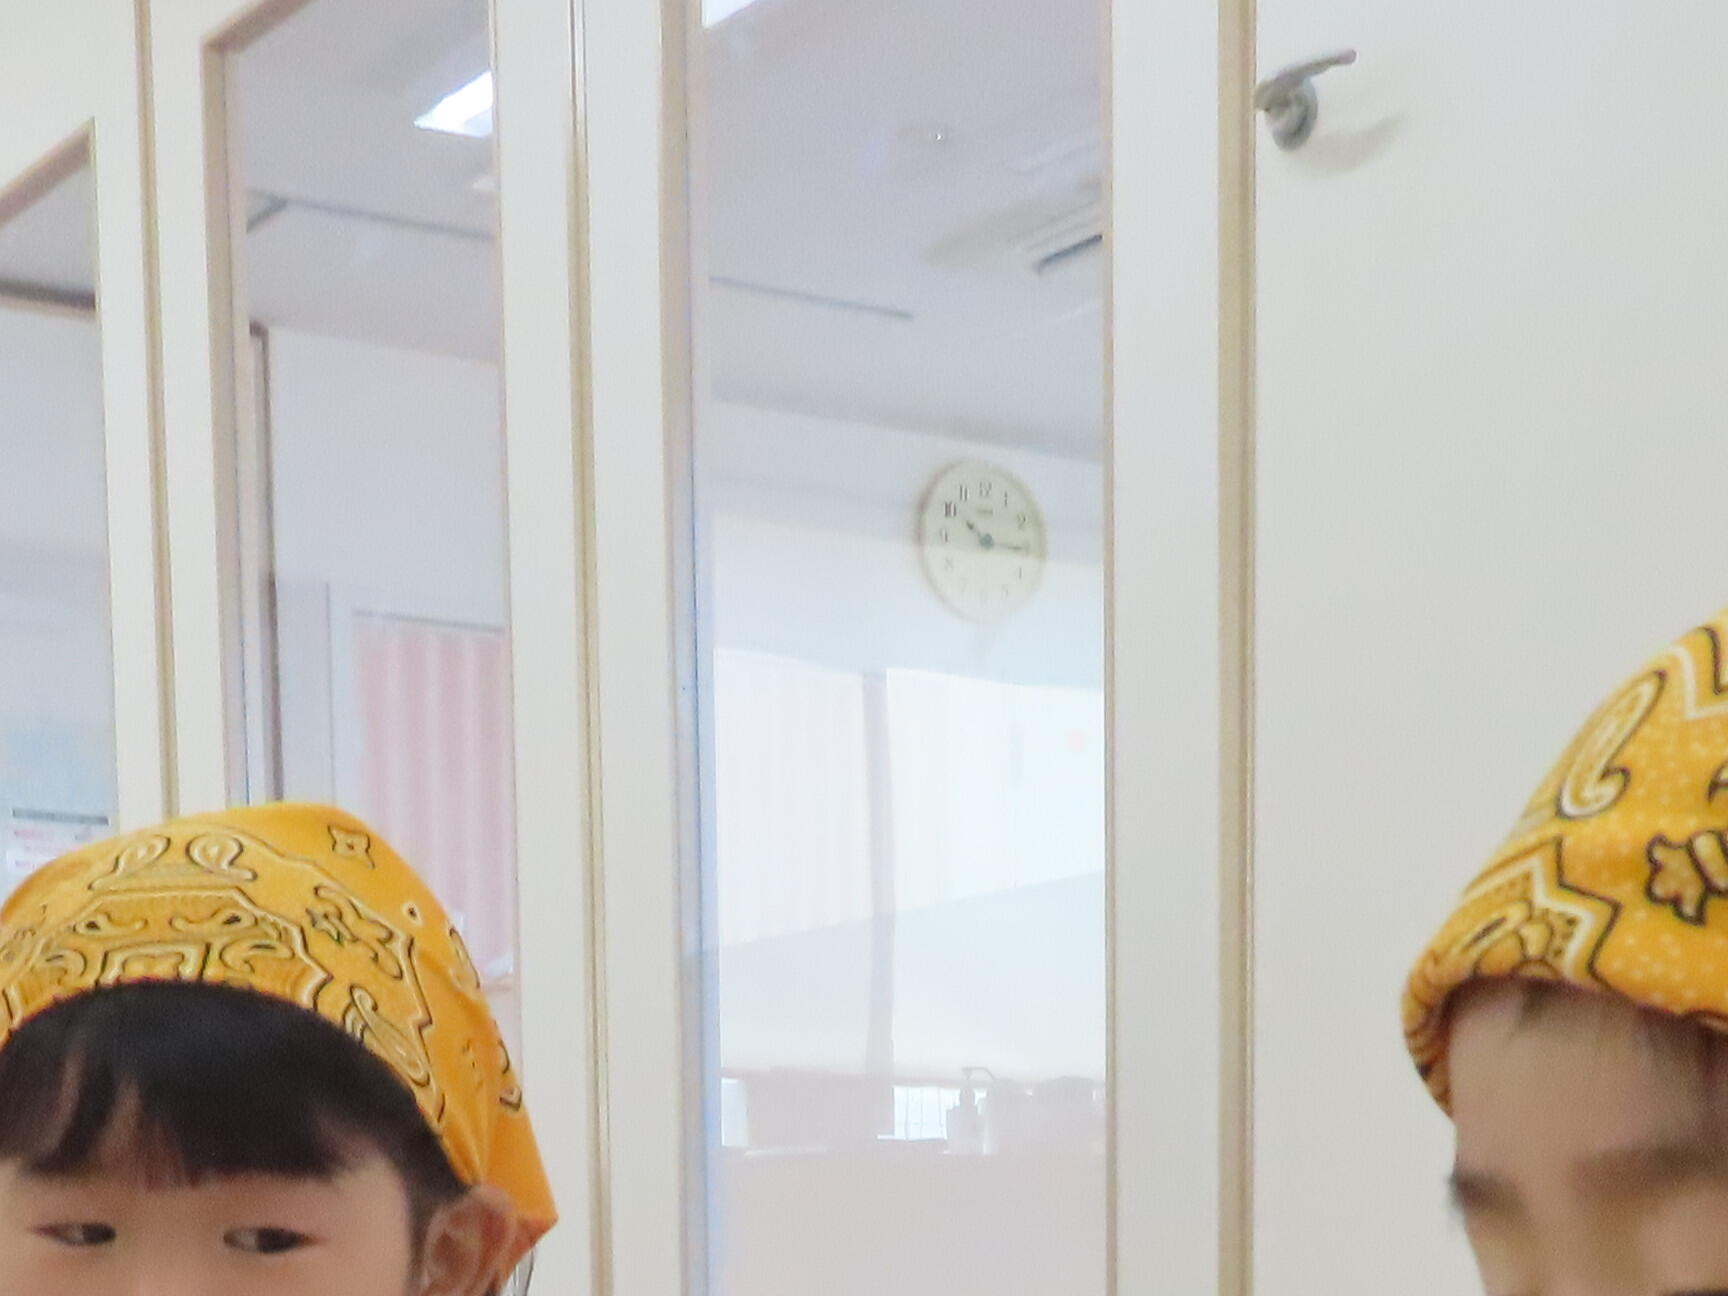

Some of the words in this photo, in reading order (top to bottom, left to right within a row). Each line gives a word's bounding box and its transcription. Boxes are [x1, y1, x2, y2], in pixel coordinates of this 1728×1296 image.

[959, 484, 968, 502] 11
[979, 481, 992, 497] 12
[944, 501, 957, 518] 10
